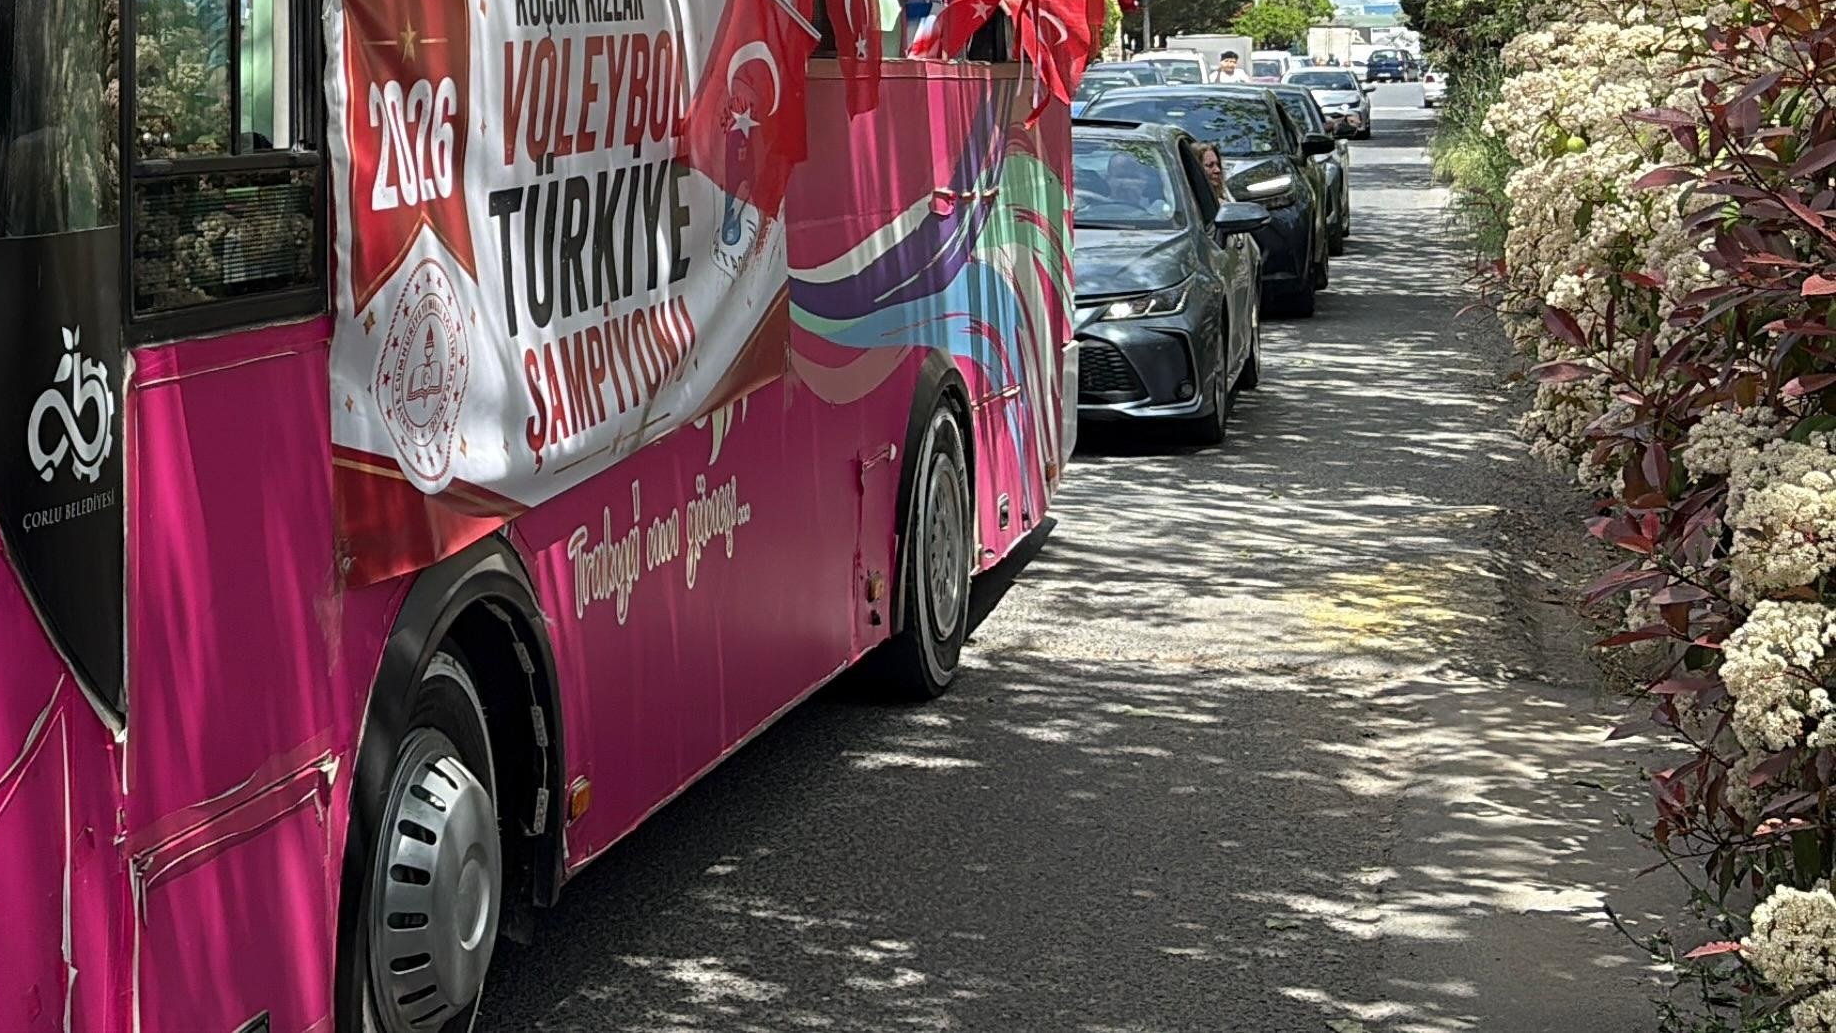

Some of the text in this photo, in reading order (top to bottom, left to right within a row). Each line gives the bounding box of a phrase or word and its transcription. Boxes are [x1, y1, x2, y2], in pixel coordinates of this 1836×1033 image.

[368, 76, 458, 211] 2026
[503, 29, 691, 166] VOLEYBOL
[488, 141, 691, 338] TÜRKİYE
[22, 488, 115, 533] ÇORLU BELEDİYESİ
